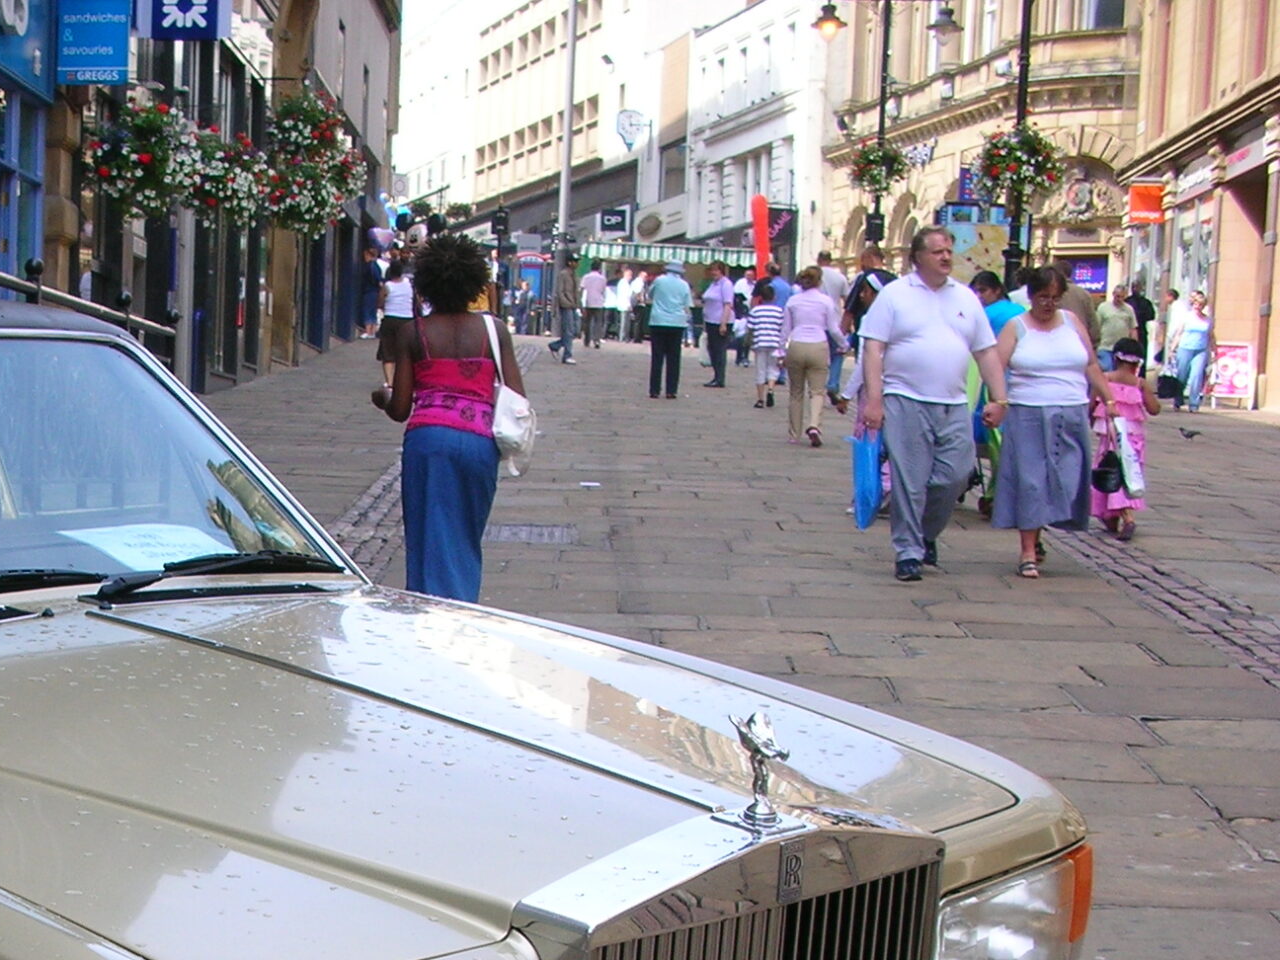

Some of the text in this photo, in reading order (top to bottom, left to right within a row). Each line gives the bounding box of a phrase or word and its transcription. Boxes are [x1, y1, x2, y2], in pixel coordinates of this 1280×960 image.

[63, 13, 127, 24] sandwiches
[64, 28, 73, 41] &
[63, 45, 113, 55] savouries
[76, 71, 119, 81] GREGGS
